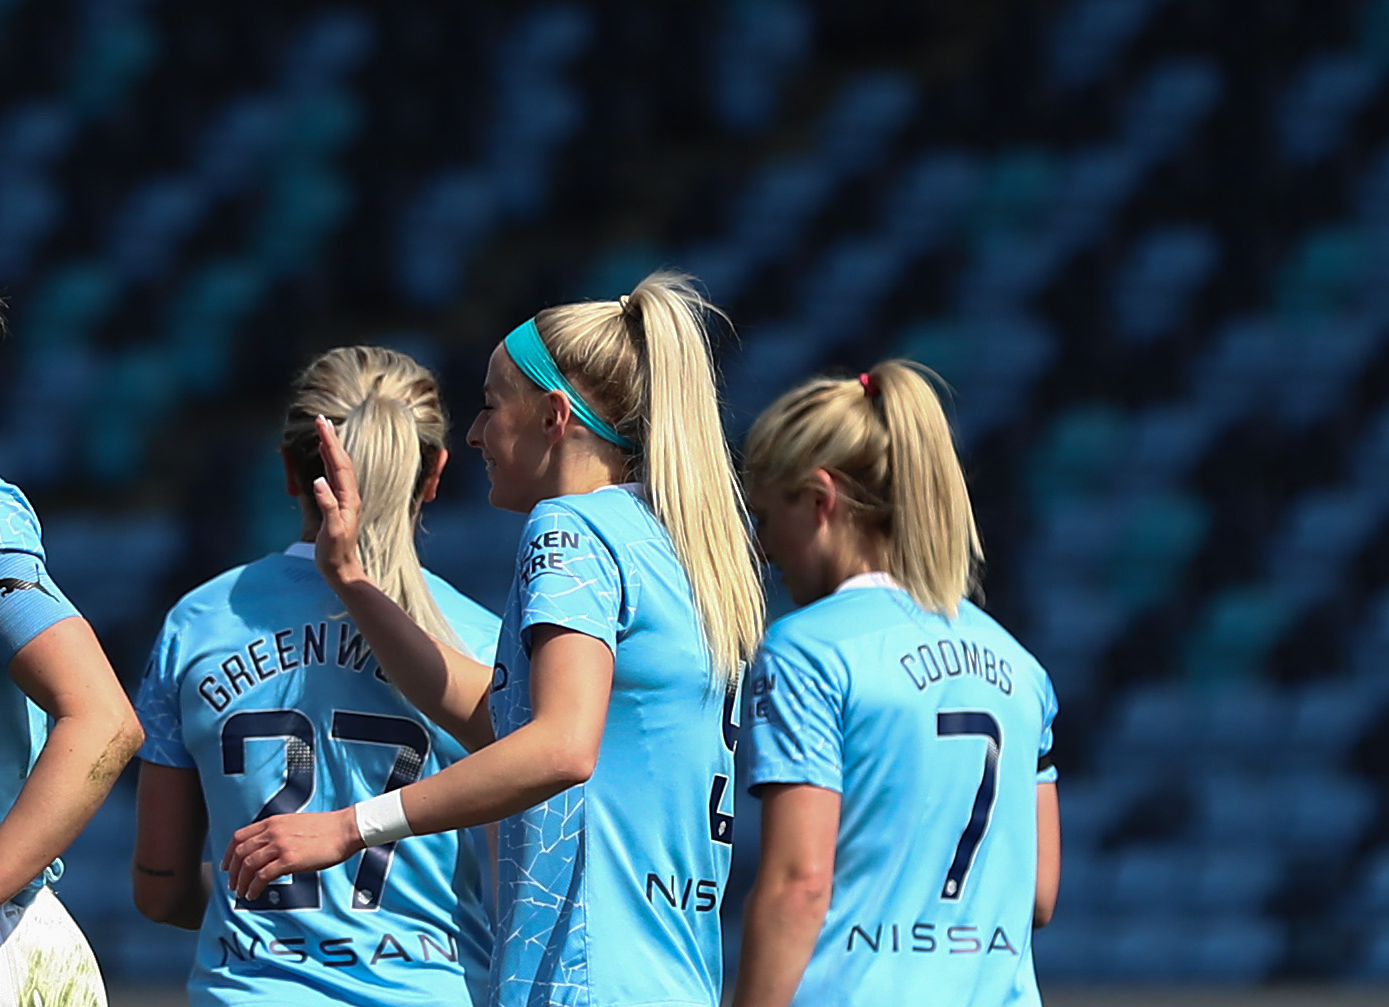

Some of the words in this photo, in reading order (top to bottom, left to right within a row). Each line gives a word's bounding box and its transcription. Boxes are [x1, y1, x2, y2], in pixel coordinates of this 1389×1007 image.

[900, 639, 1014, 696] COOMBS
[220, 709, 431, 911] 27
[936, 711, 1001, 901] 7
[218, 931, 458, 967] NISSAN
